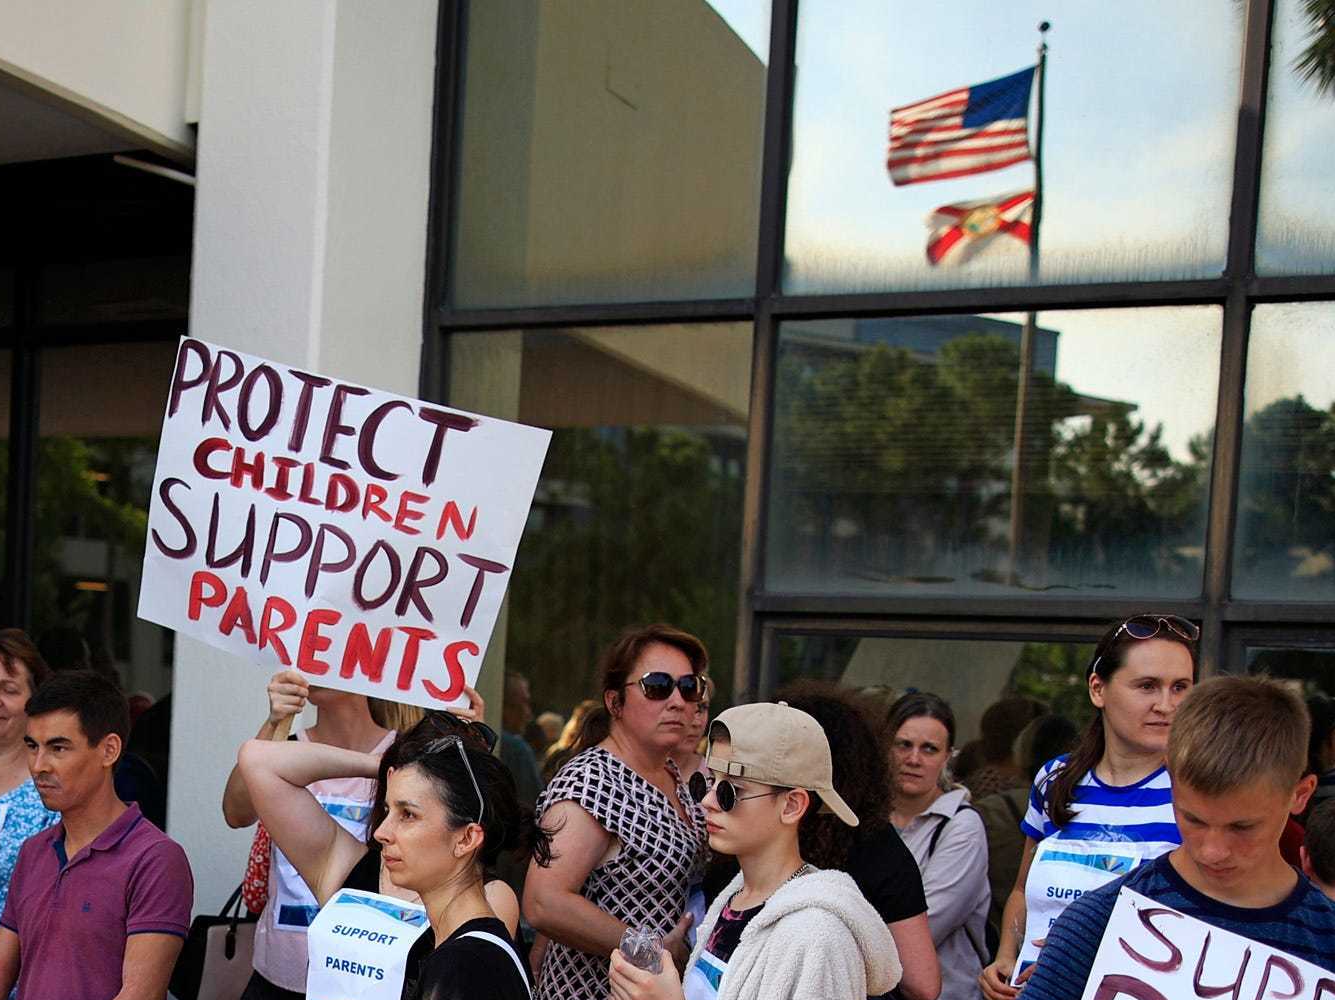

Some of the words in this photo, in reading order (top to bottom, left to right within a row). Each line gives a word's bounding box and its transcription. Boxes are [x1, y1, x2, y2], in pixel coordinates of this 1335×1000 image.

[168, 338, 481, 488] PROTECT
[192, 436, 479, 543] CHILDREN
[151, 476, 510, 630] SUPPORT
[187, 570, 481, 702] PARENTS
[325, 956, 385, 980] PARENTS
[331, 924, 399, 947] SUPPORT
